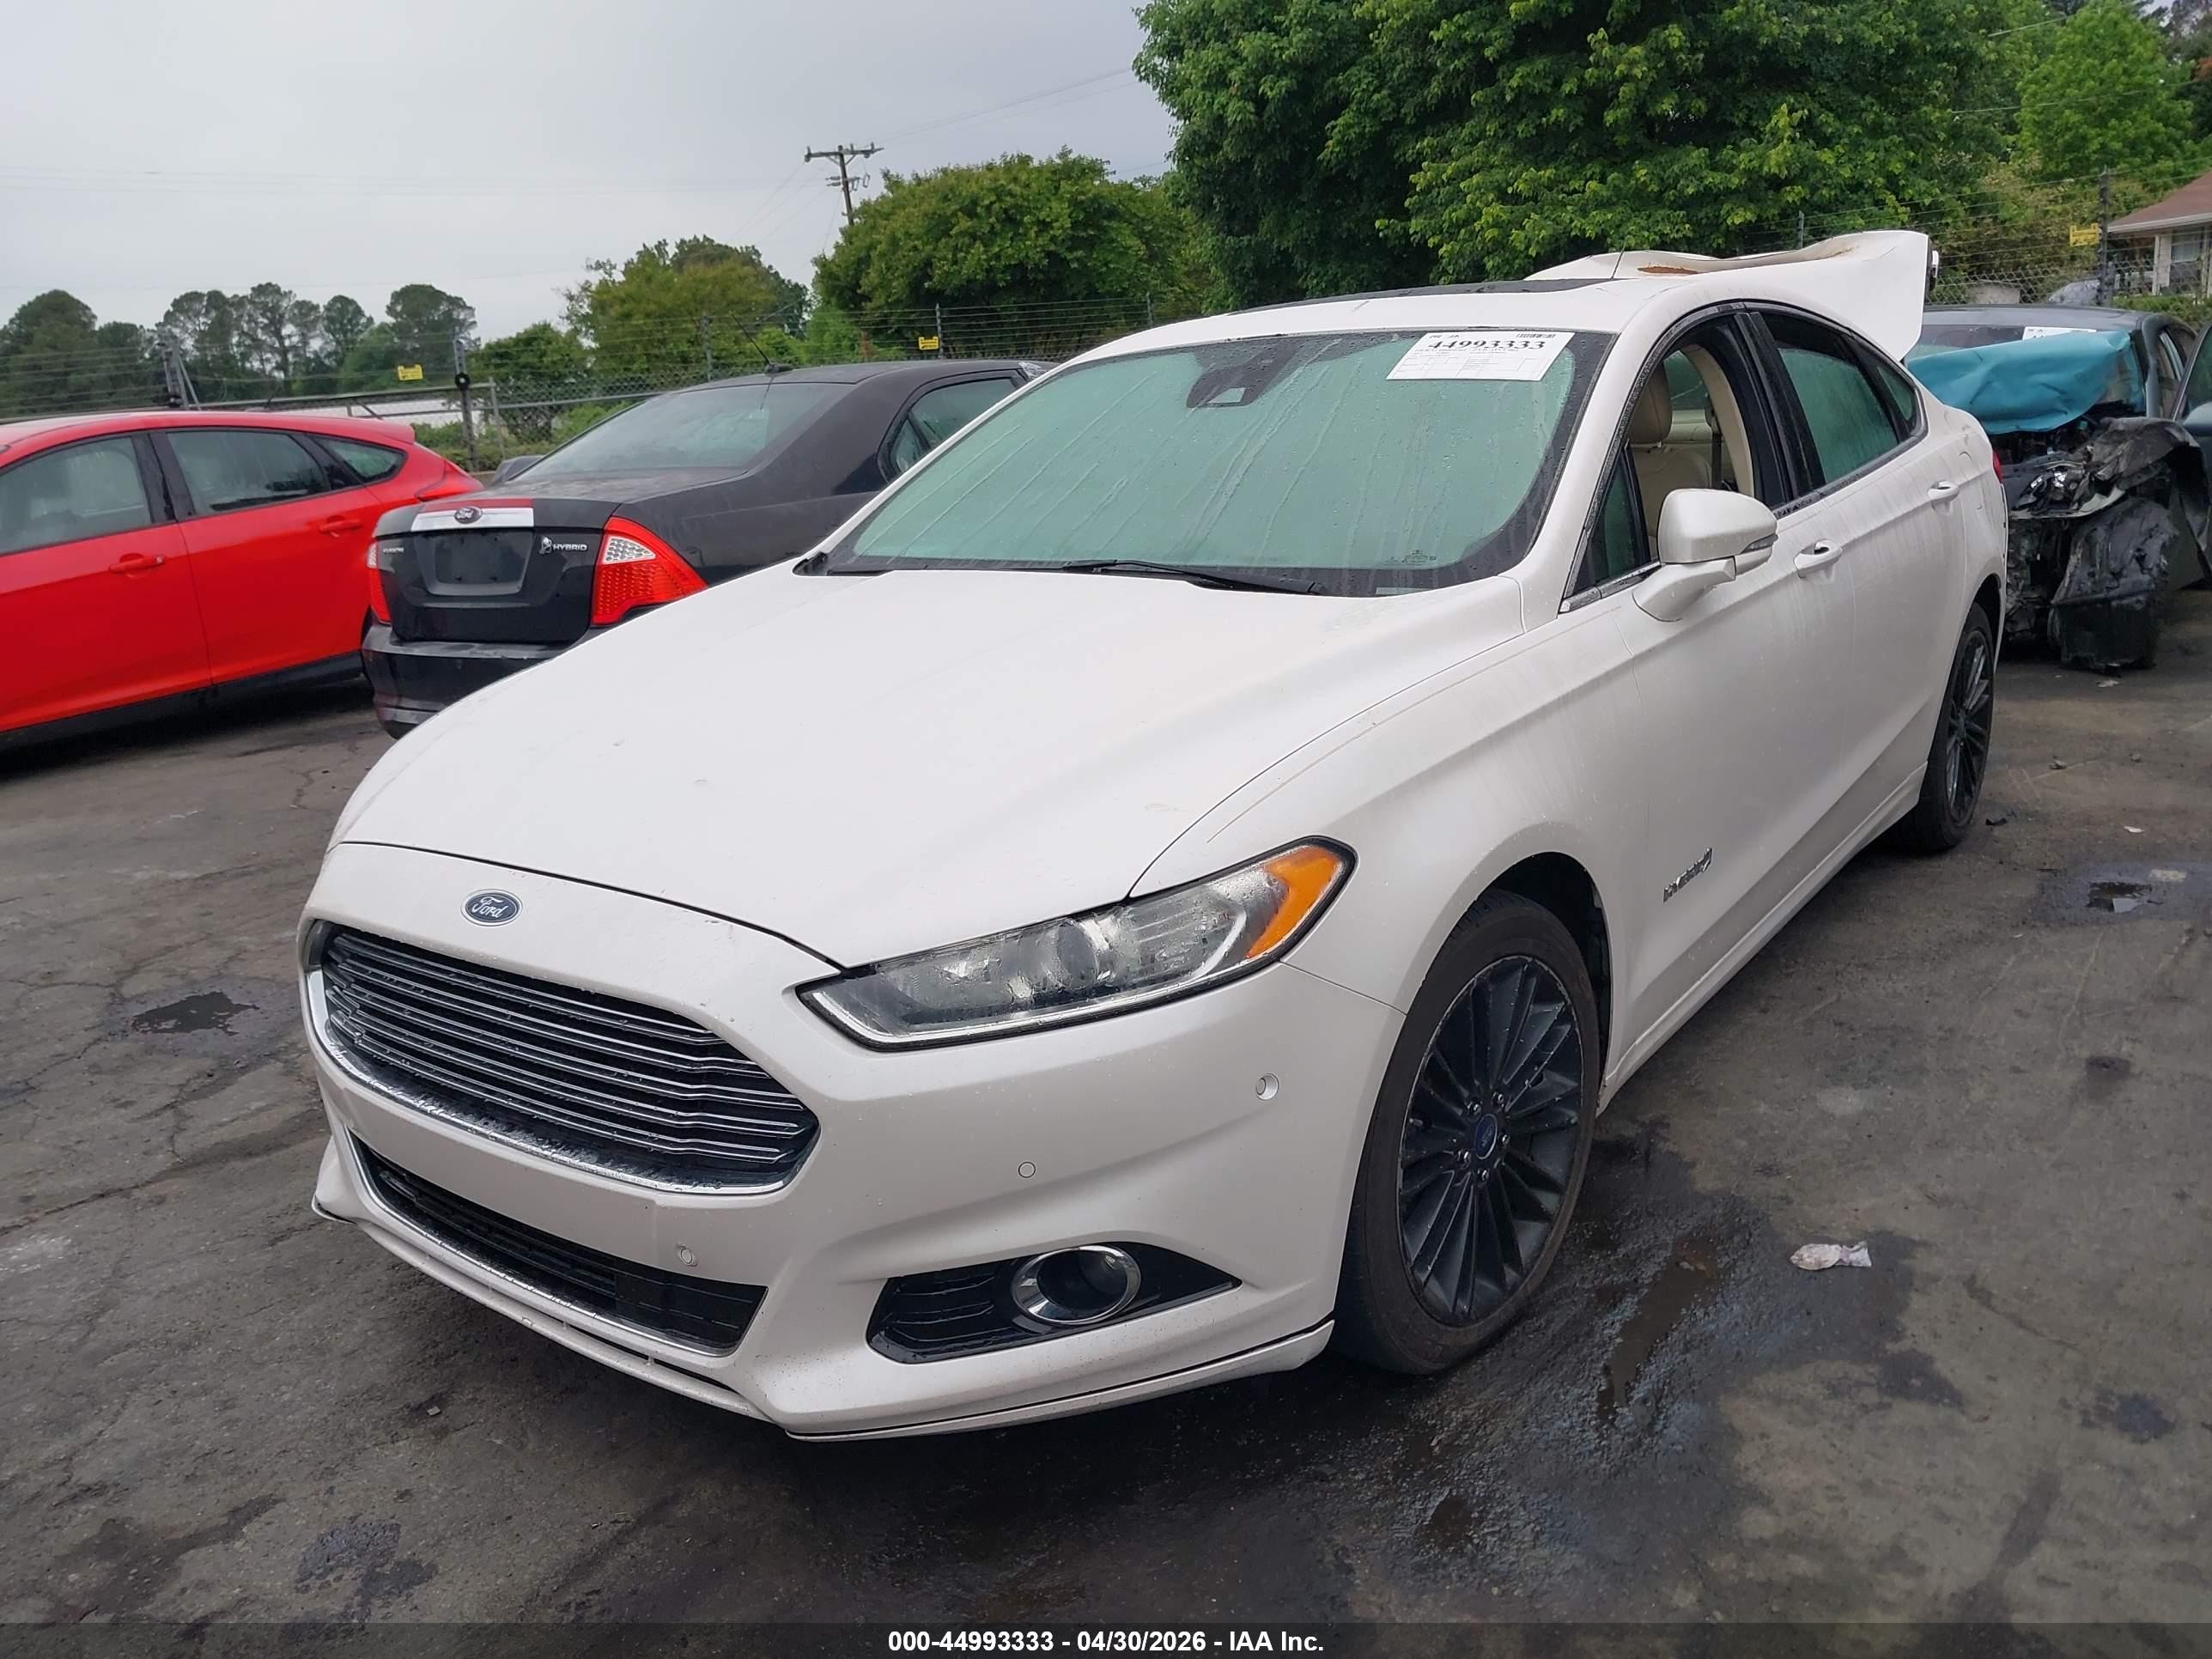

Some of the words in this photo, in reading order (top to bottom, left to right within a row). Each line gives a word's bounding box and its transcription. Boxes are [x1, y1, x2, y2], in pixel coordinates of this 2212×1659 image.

[1428, 340, 1547, 350] 44993333
[553, 543, 587, 551] HYBRID
[471, 896, 509, 918] Ford
